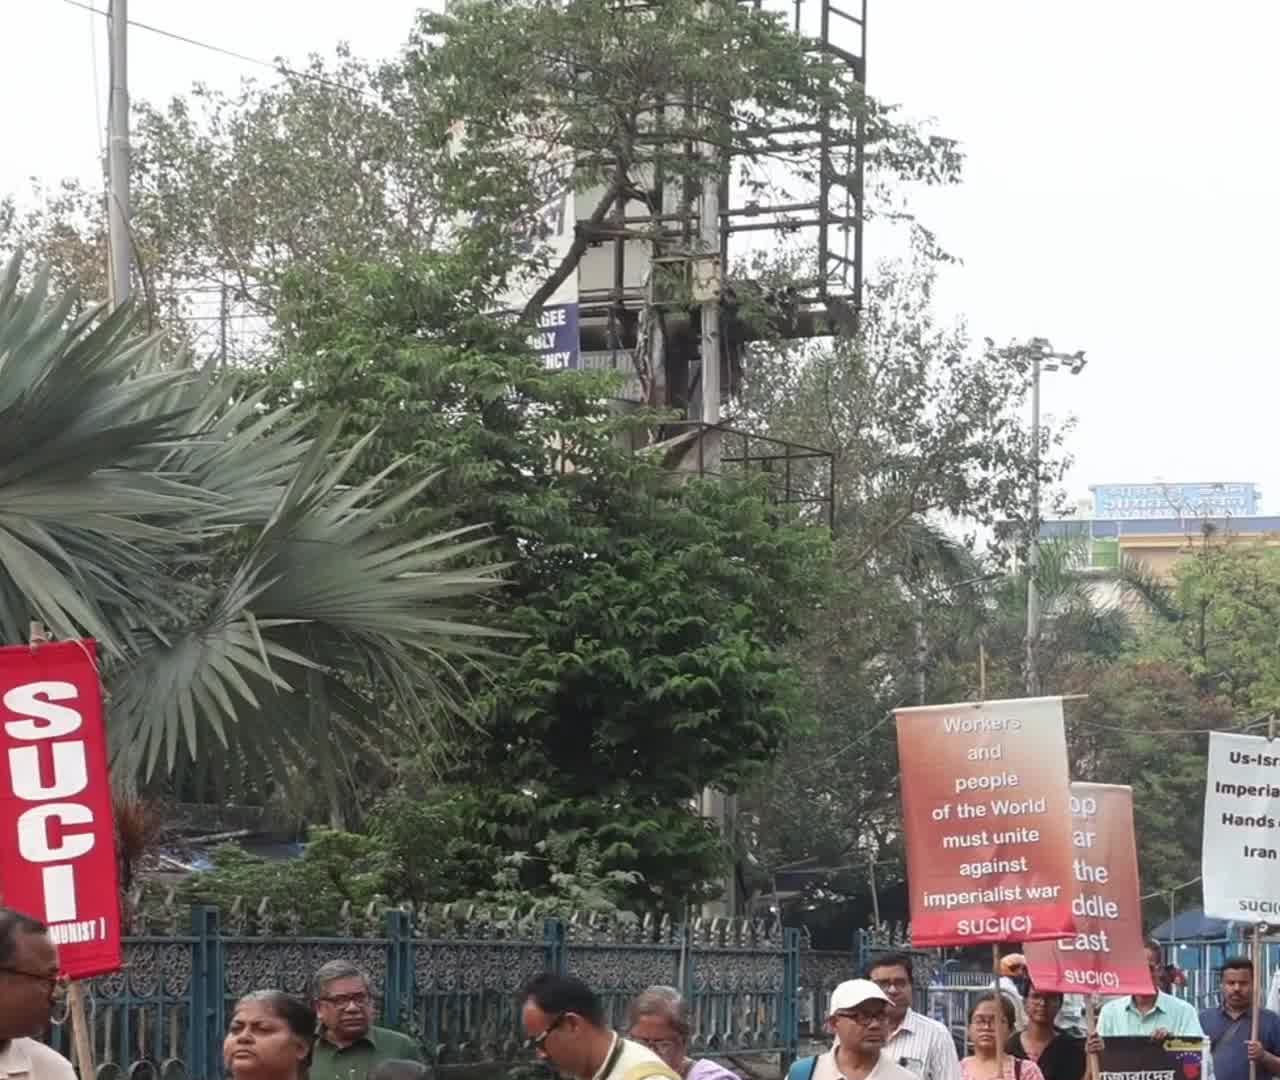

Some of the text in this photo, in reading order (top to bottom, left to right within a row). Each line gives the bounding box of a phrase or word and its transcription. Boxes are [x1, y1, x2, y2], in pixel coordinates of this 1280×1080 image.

[943, 716, 1022, 733] Workers
[967, 745, 1002, 761] and
[955, 772, 1019, 793] people
[3, 681, 95, 923] SUCI
[931, 797, 1047, 820] of the World
[1221, 812, 1275, 830] Hands
[943, 827, 1041, 849] must unite
[1072, 831, 1096, 848] ar
[1244, 845, 1277, 859] Iran
[959, 856, 1028, 879] against
[1072, 858, 1109, 884] the
[923, 884, 1061, 908] imperialist war
[1071, 894, 1119, 919] ddle
[956, 916, 1032, 936] SUCI(C)
[1064, 969, 1120, 989] SUCI(C)
